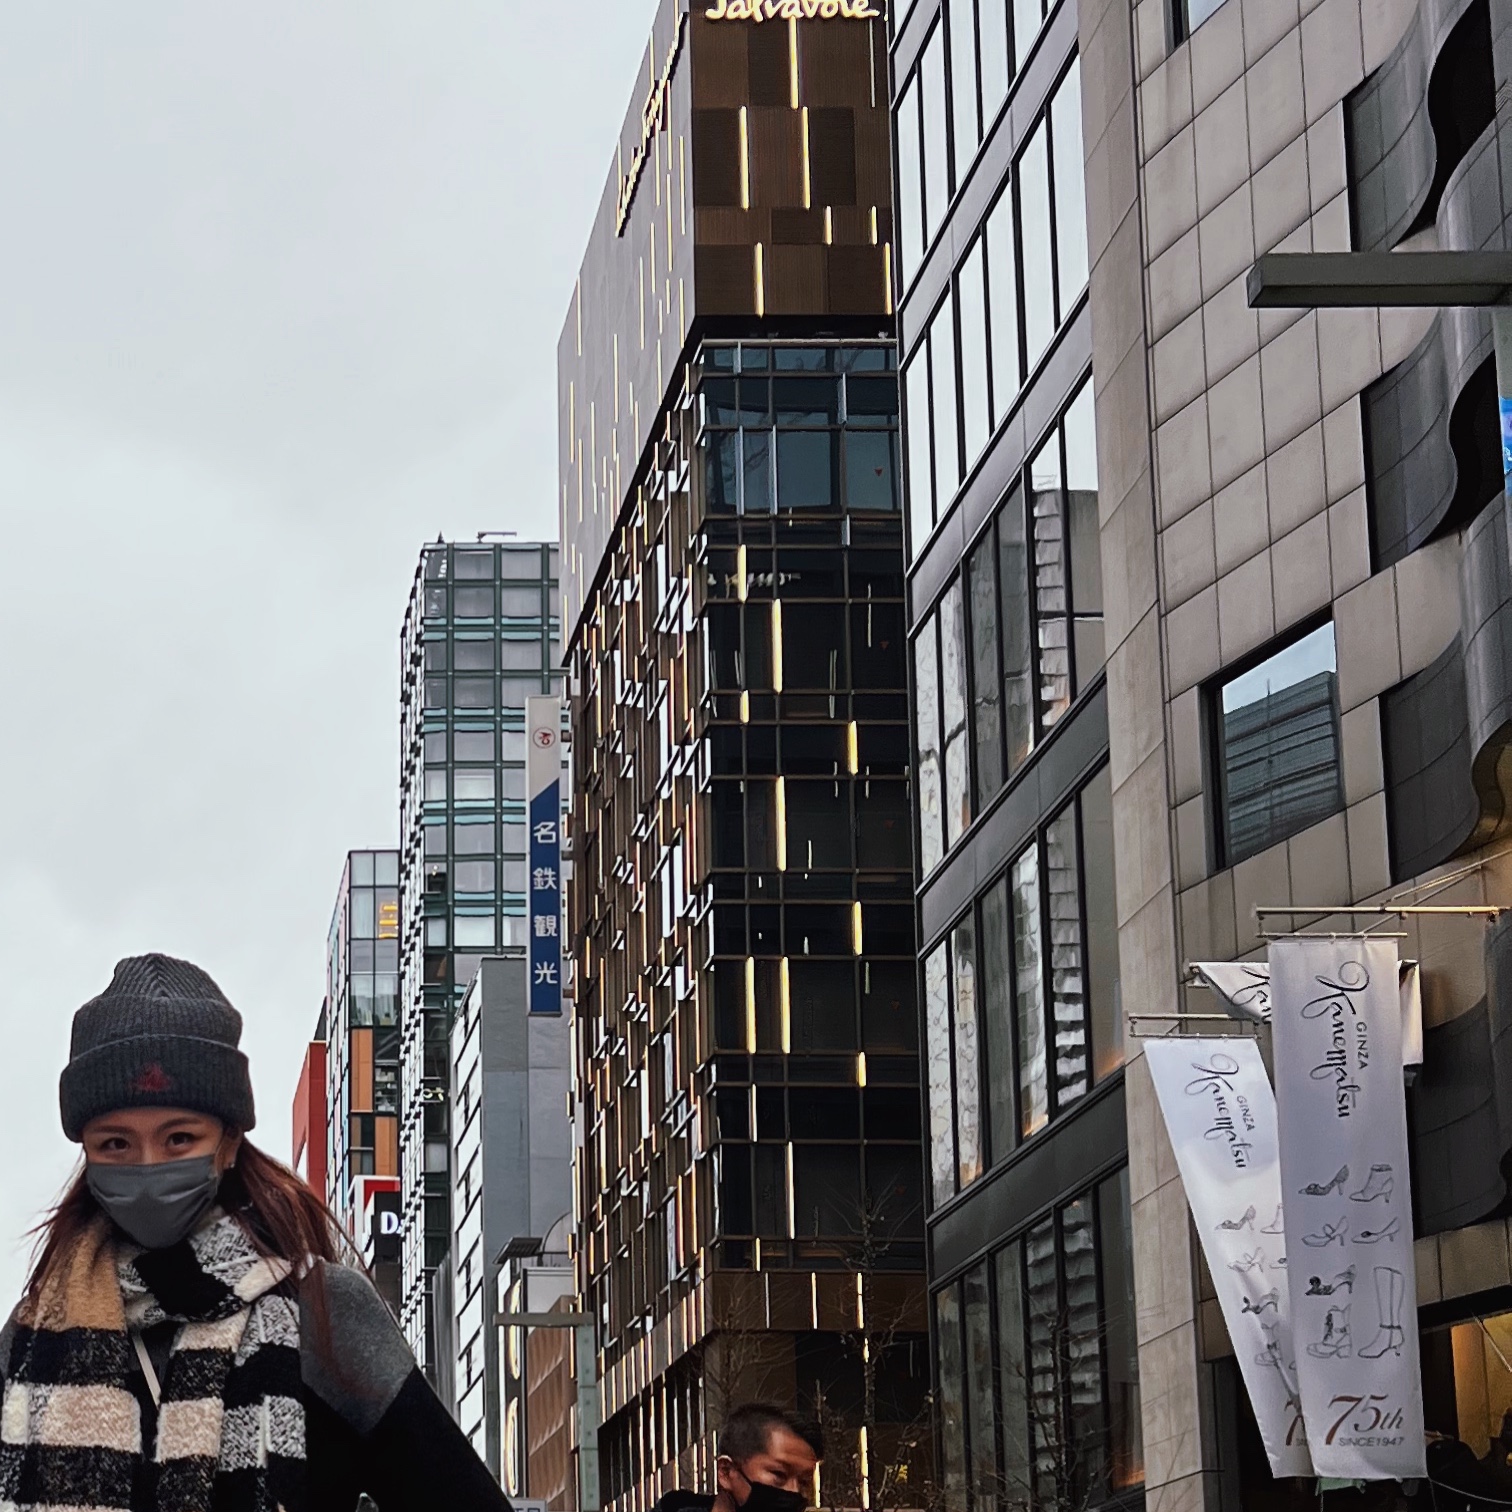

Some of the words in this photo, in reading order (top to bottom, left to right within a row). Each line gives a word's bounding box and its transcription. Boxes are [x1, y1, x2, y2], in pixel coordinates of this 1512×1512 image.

[532, 821, 559, 985] 名鉄観光
[1301, 960, 1370, 1118] Kanematsu
[1354, 1021, 1370, 1070] GINZA
[1236, 1095, 1255, 1131] GINZA
[1325, 1394, 1404, 1446] 75th
